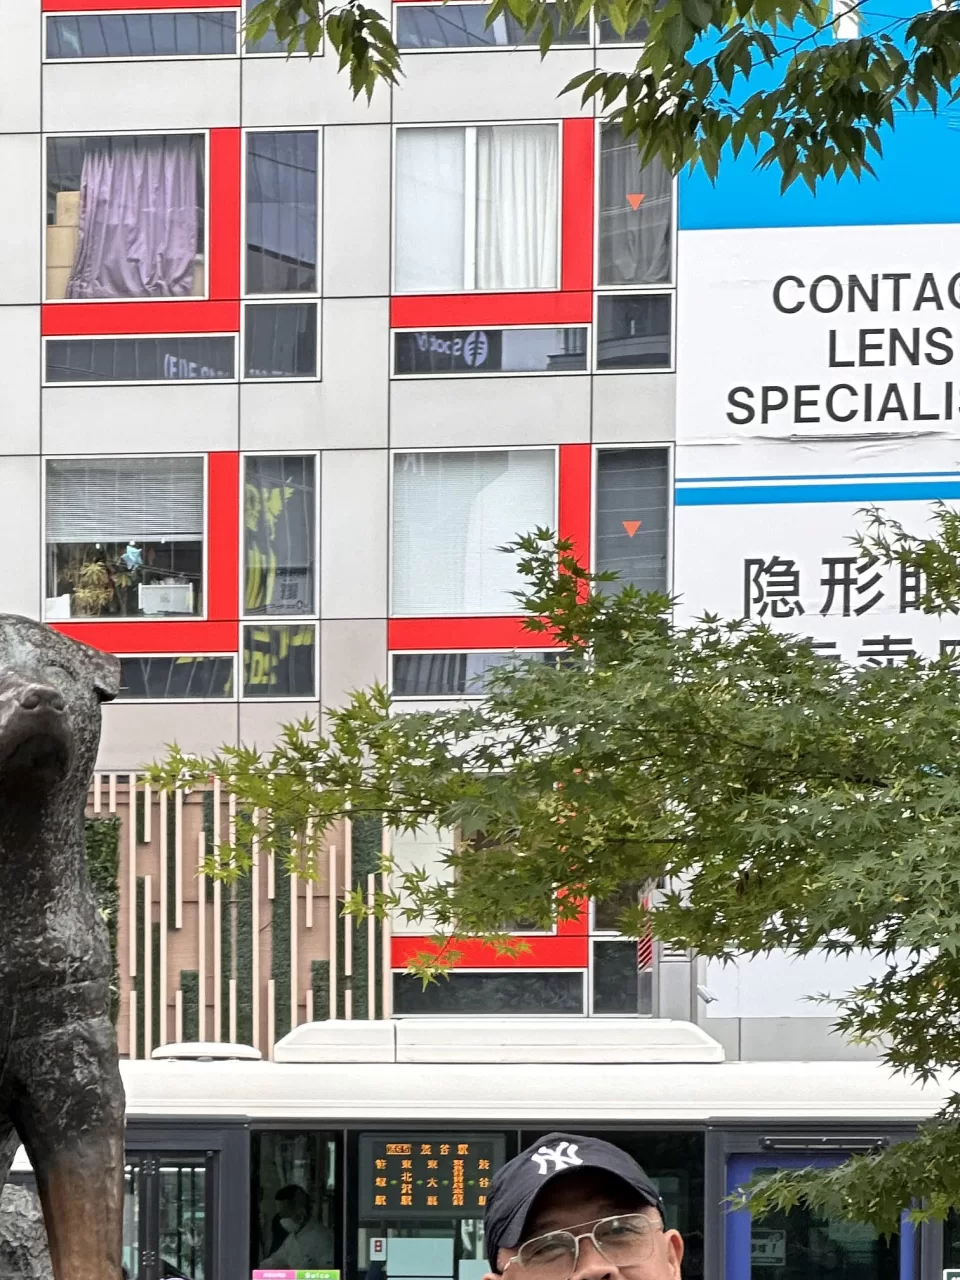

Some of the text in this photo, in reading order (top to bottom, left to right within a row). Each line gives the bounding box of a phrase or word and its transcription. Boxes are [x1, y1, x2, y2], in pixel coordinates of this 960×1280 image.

[828, 326, 954, 368] LENS
[726, 381, 960, 425] SPECIALI
[530, 1141, 584, 1175] NY
